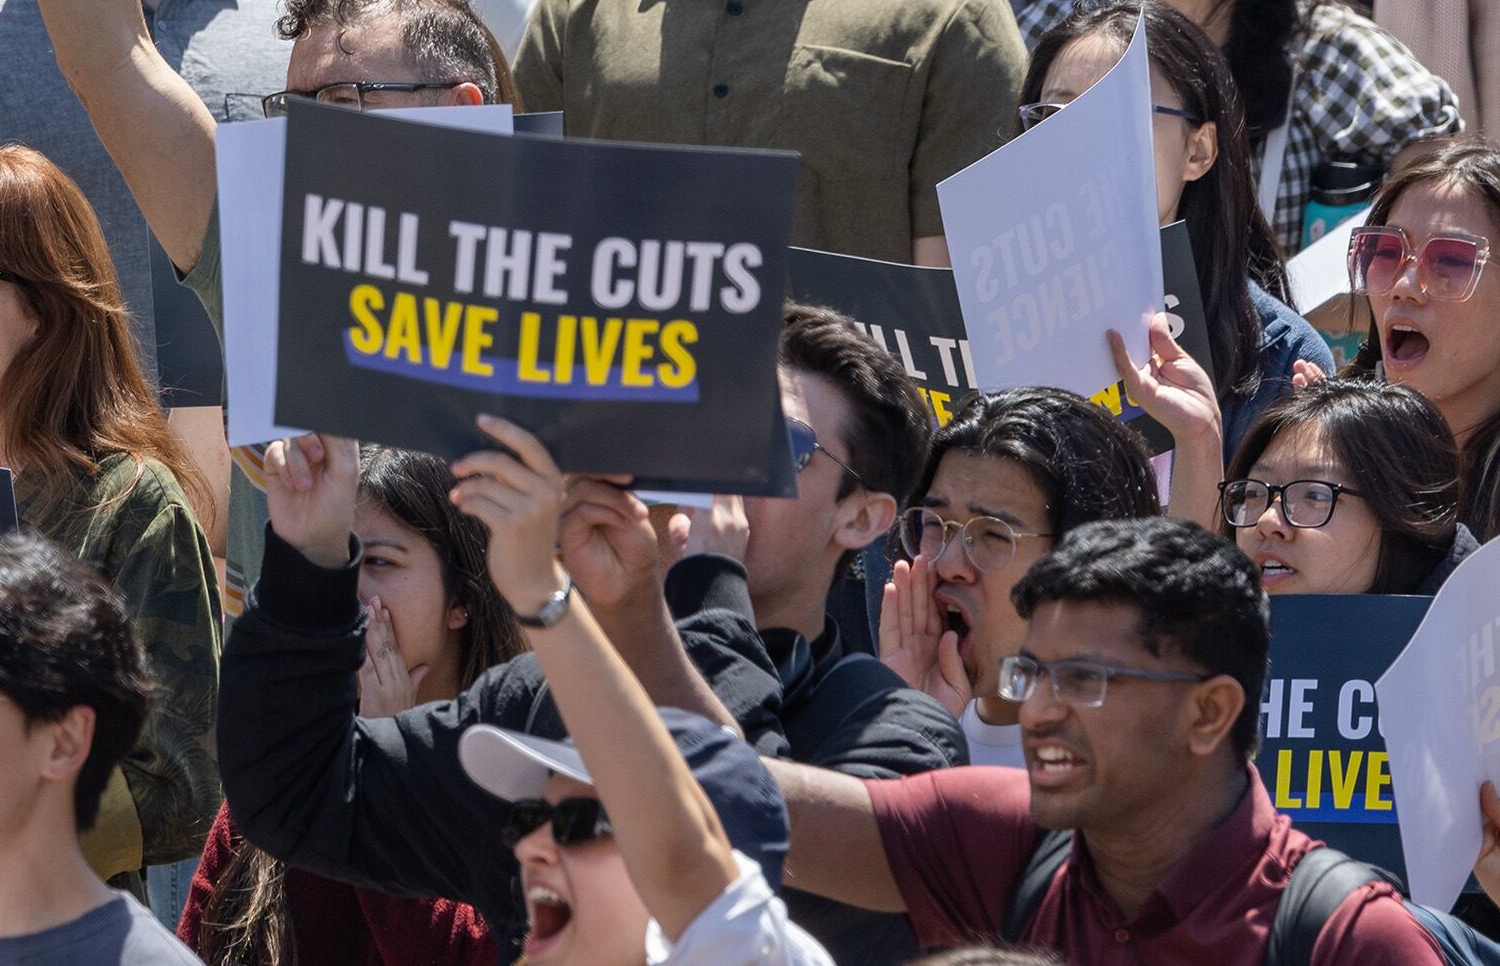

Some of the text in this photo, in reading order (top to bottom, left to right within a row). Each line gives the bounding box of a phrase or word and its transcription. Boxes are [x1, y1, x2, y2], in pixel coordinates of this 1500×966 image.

[300, 192, 765, 315] KILL THE CUTS
[346, 283, 700, 390] SAVE LIVES
[1275, 749, 1393, 811] LIVE
